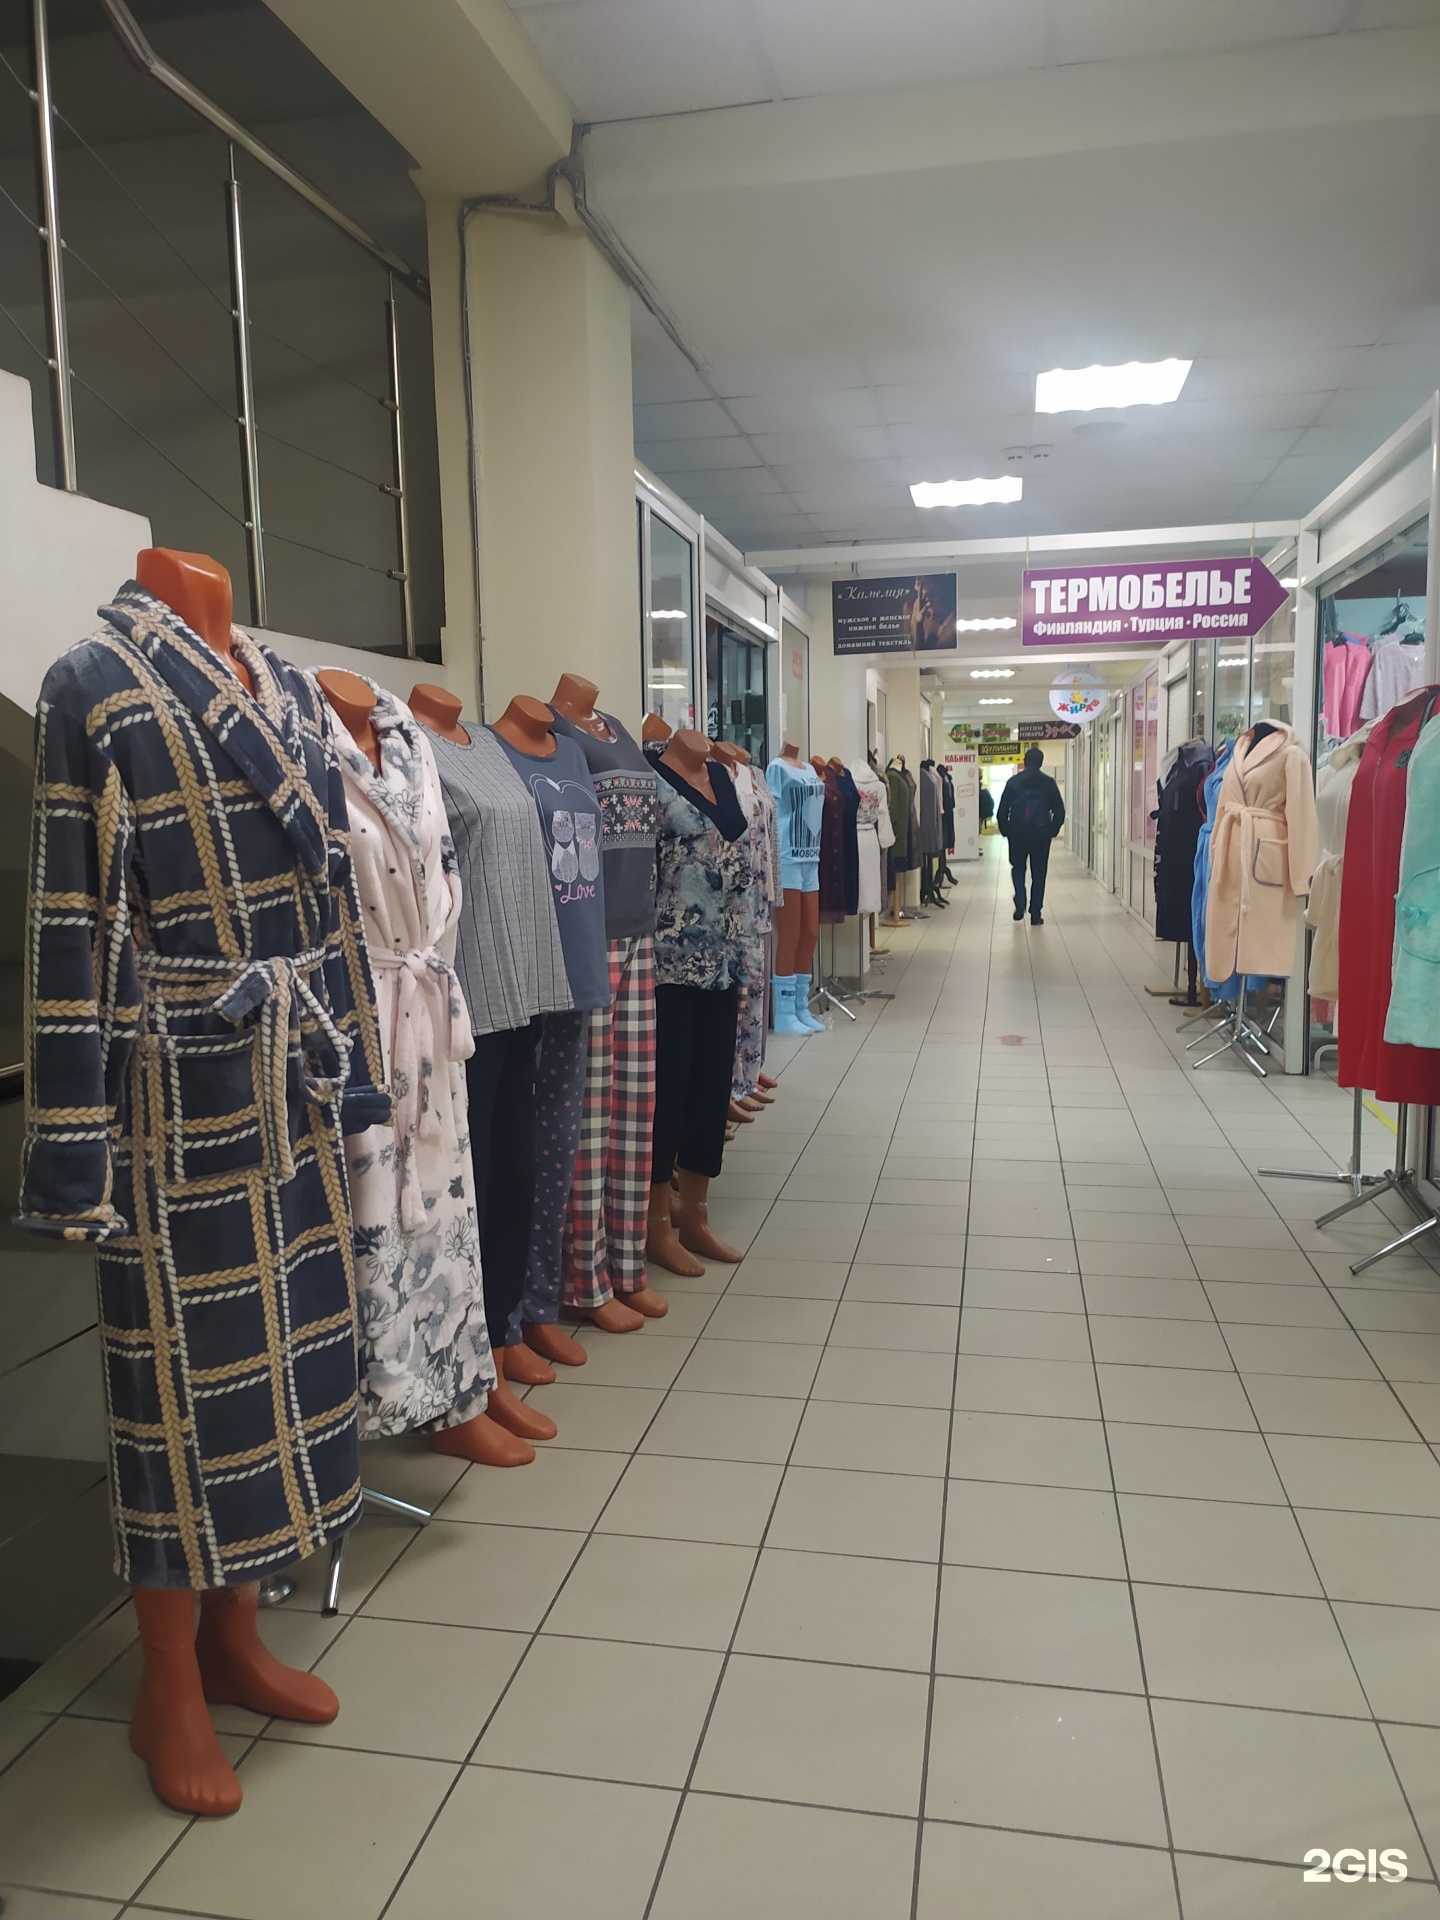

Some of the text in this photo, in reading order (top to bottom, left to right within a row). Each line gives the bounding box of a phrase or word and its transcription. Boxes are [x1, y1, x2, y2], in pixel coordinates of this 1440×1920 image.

[1030, 568, 1252, 614] ТЕРМОБЕЛЬЕ
[1033, 612, 1249, 636] Финляндия Турция Россия
[838, 639, 912, 649] домашний текстиль
[1056, 698, 1101, 715] ЖИРАФ
